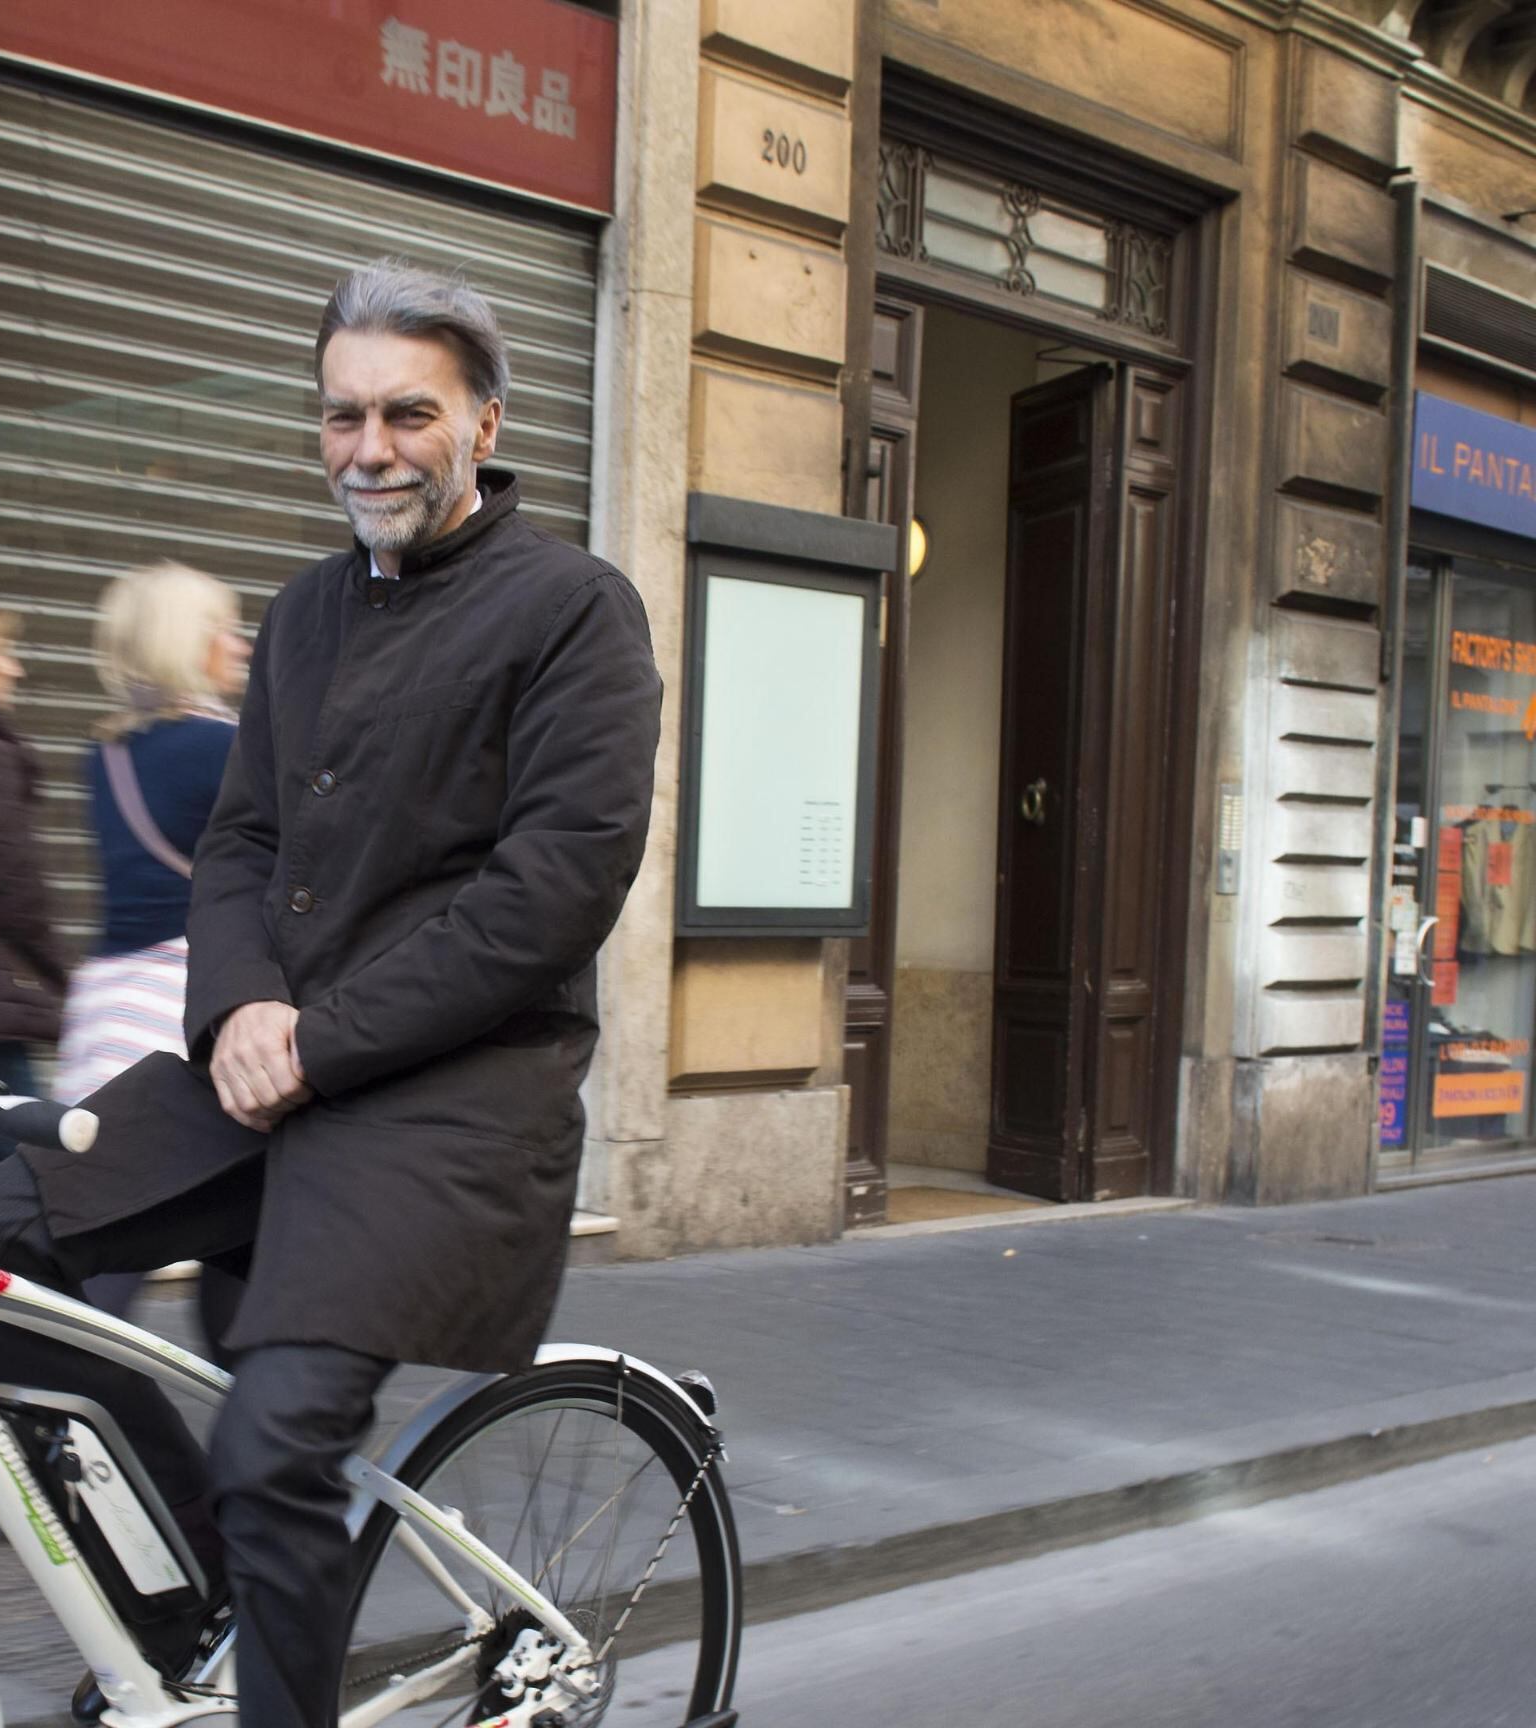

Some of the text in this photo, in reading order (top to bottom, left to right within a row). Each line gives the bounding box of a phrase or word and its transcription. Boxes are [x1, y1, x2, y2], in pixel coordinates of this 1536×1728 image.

[379, 17, 576, 140] 無印良品
[762, 129, 807, 175] 200
[1420, 432, 1536, 501] IL PANTA
